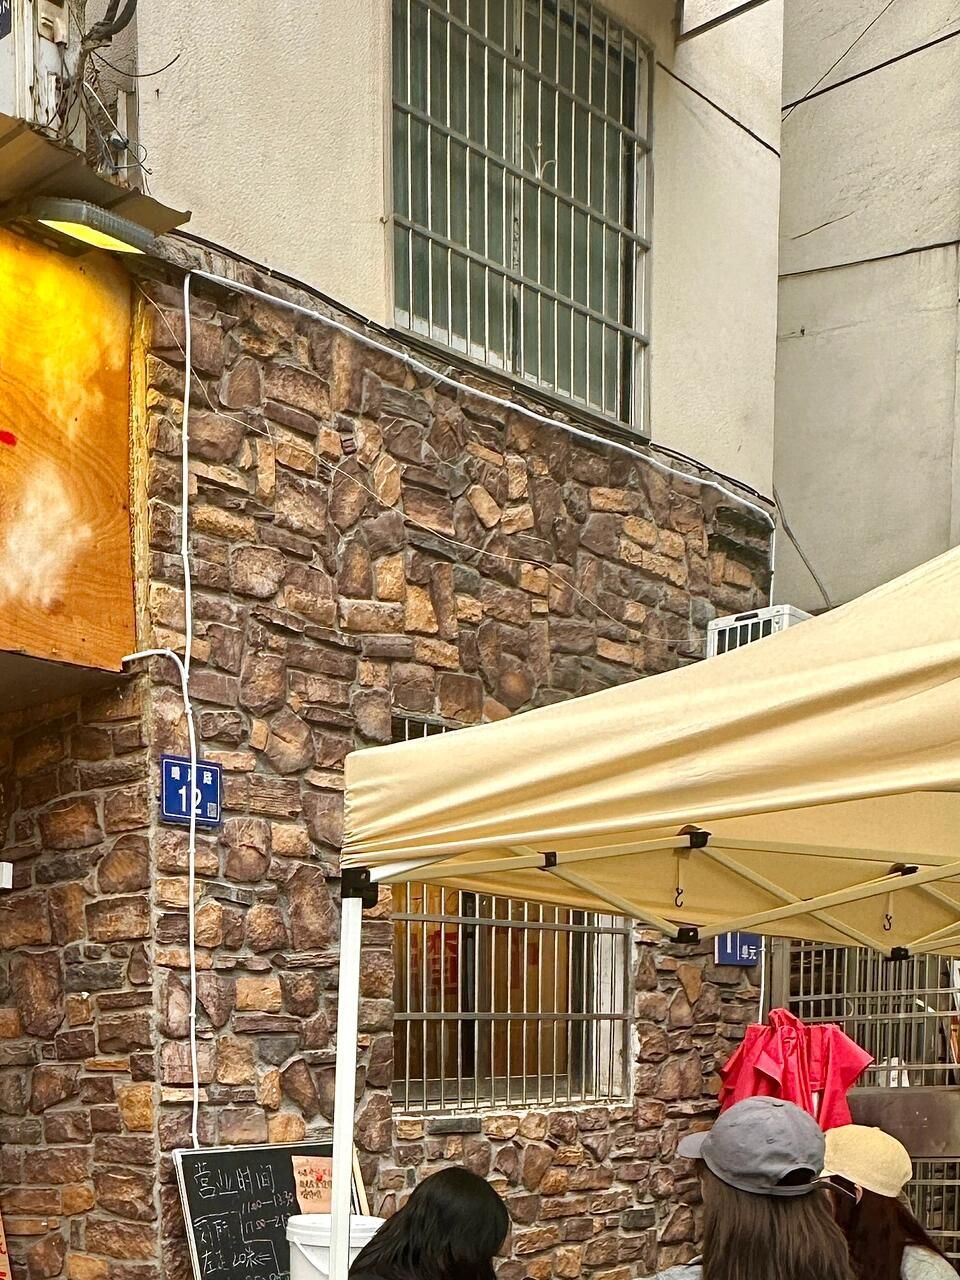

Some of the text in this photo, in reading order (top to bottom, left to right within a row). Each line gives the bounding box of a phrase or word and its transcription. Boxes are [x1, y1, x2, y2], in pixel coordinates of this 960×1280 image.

[178, 785, 202, 814] 12
[741, 944, 757, 960] 单元
[194, 1162, 276, 1198] 营业时间
